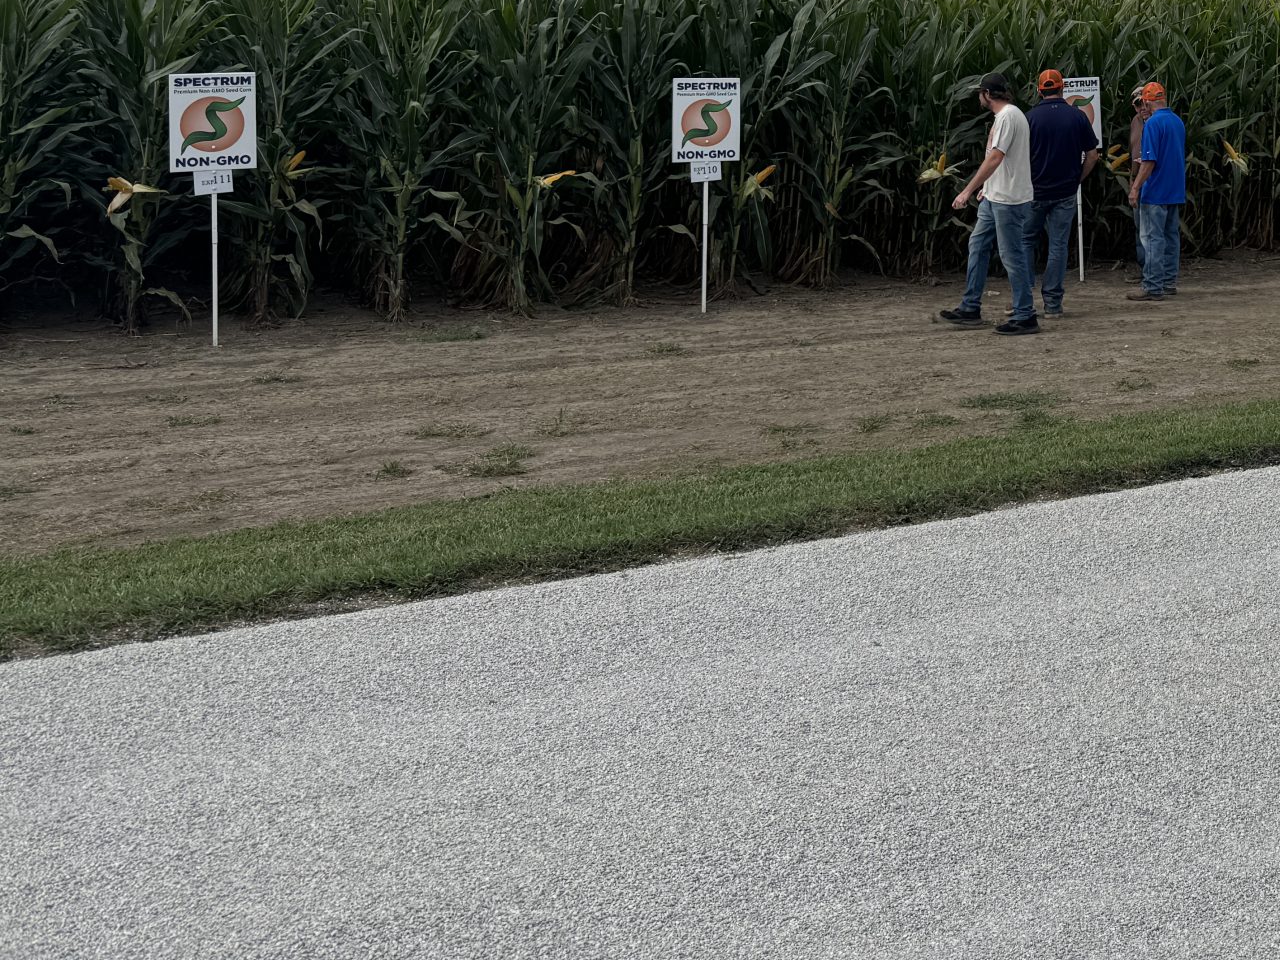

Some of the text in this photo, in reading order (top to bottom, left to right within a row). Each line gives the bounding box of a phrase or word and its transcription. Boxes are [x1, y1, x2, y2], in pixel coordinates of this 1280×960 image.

[173, 76, 252, 87] SPECTRUM
[677, 82, 737, 91] SPECTRUM
[677, 149, 736, 160] NON-GMO
[175, 154, 252, 168] NON-GMO
